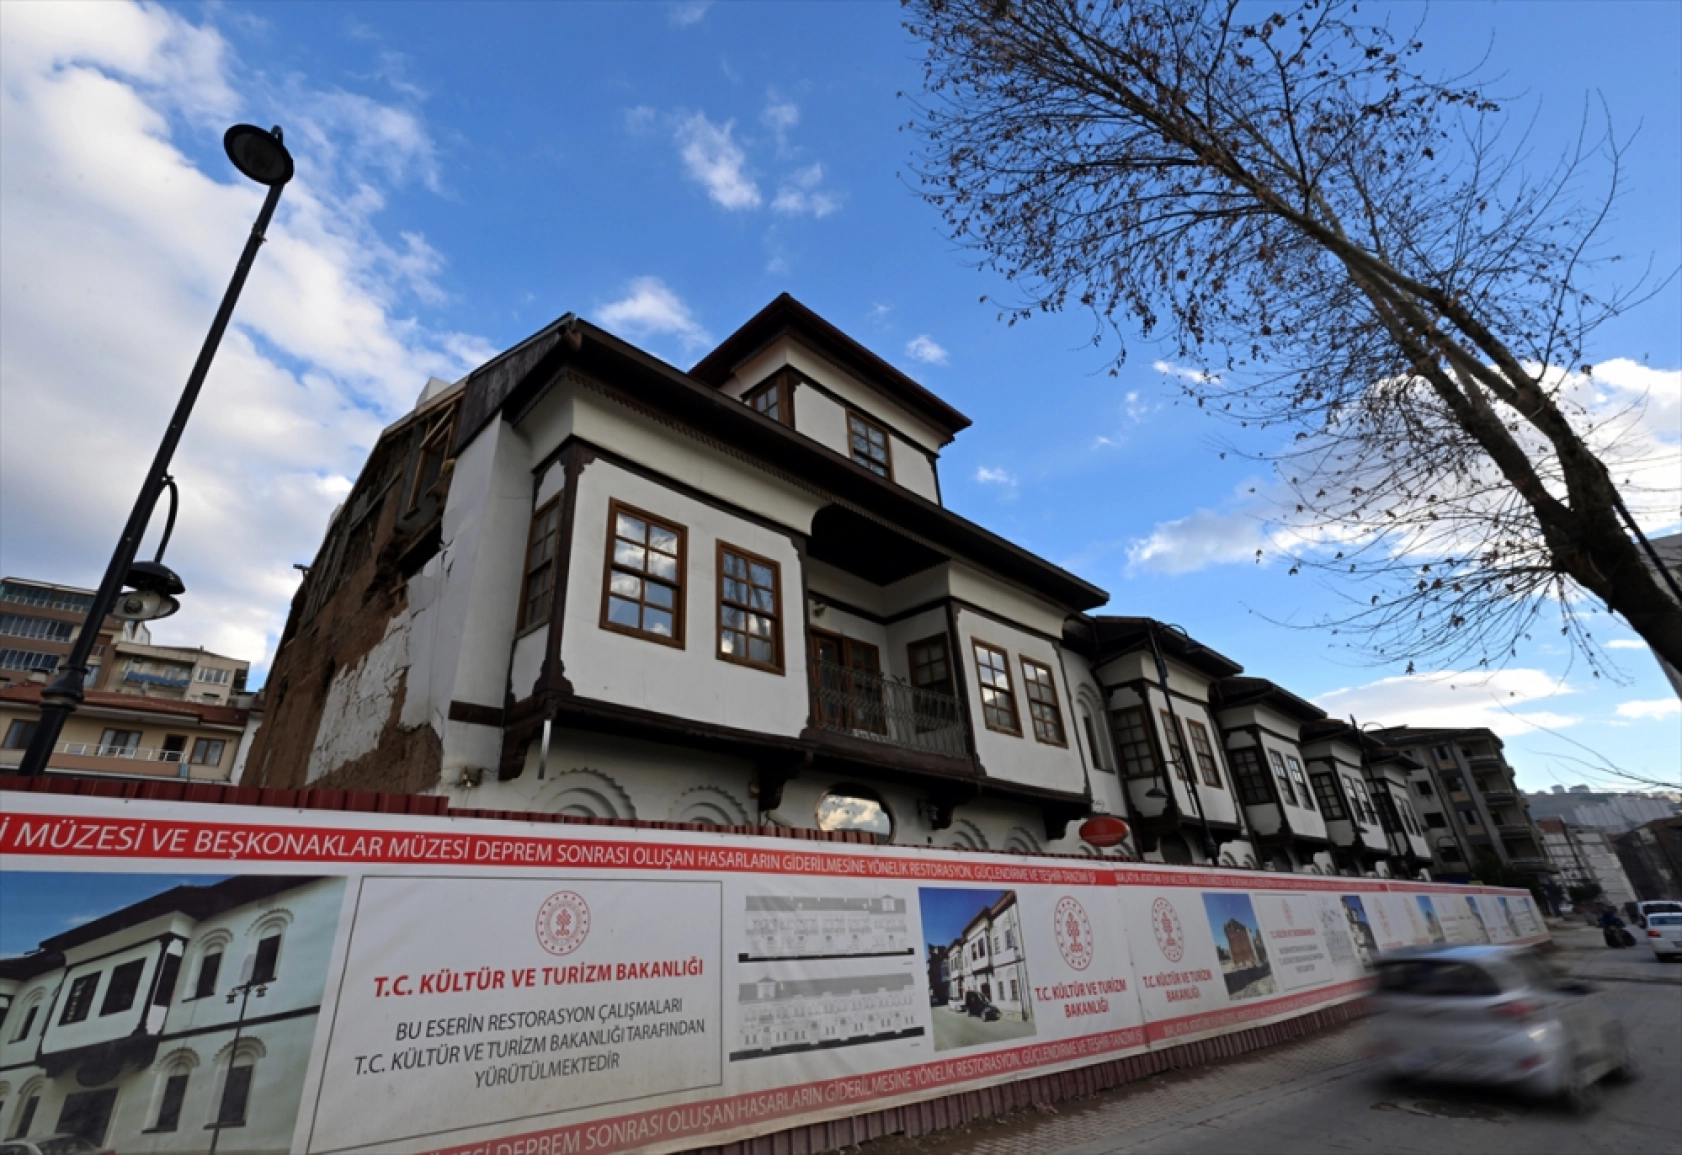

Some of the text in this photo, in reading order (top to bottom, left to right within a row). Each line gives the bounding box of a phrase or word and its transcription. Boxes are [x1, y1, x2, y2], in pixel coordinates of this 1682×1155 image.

[13, 819, 147, 850] MÜZESİ
[152, 827, 190, 852] VE
[194, 828, 383, 860] BEŞKONAKLAR
[388, 834, 471, 860] MÜZESİ
[474, 840, 551, 863] DEPREM
[556, 844, 629, 865] SONRASI
[632, 847, 694, 870] OLUŞAN
[698, 850, 780, 870] HASARLARIN
[782, 852, 866, 875] GİDERİLMESİNE
[868, 857, 909, 876] YÖNELİK
[374, 956, 703, 997] T.C. KÜLTÜR VE TURİZM BAKANLIĞI
[1035, 977, 1128, 1001] T.C. KÜLTÜR VE TURİZM
[395, 997, 683, 1041] BU ESERİN RESTORASYON ÇALIŞMALARI
[1064, 997, 1110, 1018] BAKANLIĞI
[354, 1018, 706, 1075] T.C. KÜLTÜR VE TURİZM BAKANLIĞI TARAFINDAN
[475, 1050, 620, 1088] YÜRÜTÜLMEKTEDİR
[497, 1129, 580, 1155] DEPREM
[585, 1114, 663, 1151] SONRASI
[667, 1103, 735, 1132] OLUŞAN
[737, 1086, 822, 1118] HASARLARIN
[825, 1070, 912, 1102] GİDERİLMESİNE
[913, 1060, 956, 1086] YÖNELİK
[957, 1052, 1021, 1077] RESTORASYON,
